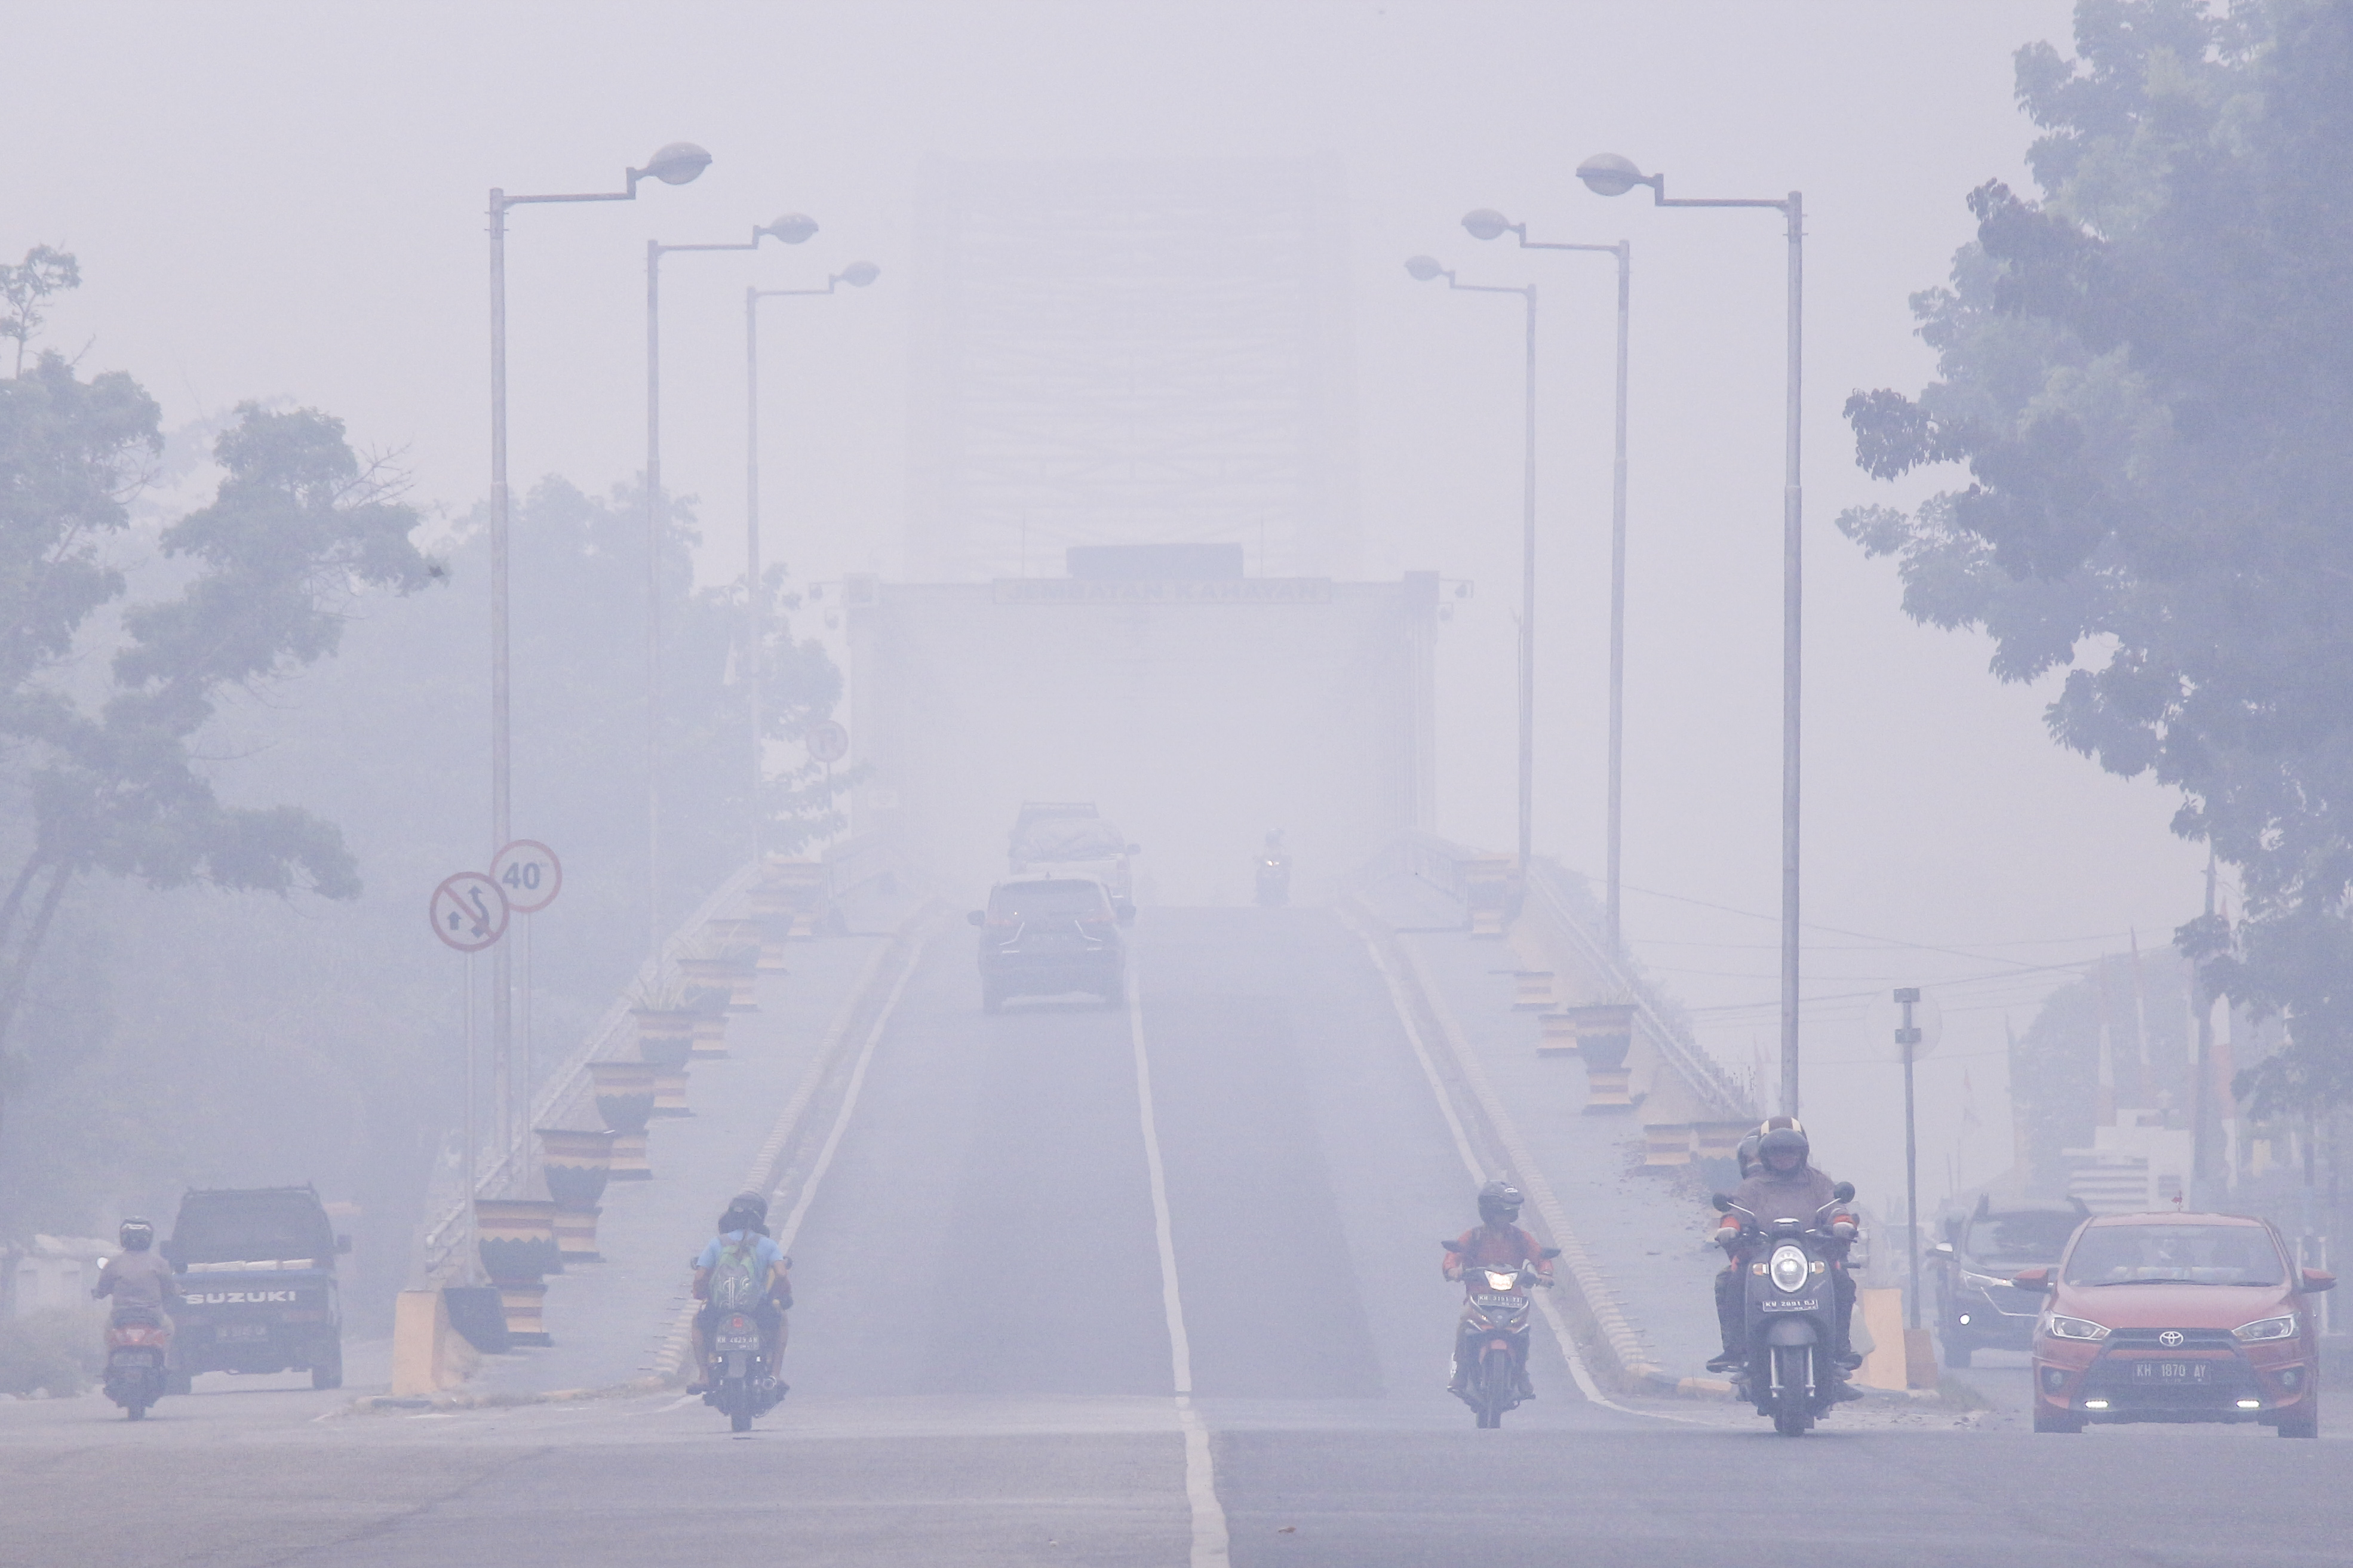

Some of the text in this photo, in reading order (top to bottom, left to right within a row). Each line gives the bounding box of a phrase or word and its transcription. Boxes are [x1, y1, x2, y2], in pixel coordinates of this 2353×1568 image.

[1007, 583, 1317, 599] JEMBATAN KAHAYAN
[502, 862, 541, 890] 40
[186, 1290, 296, 1305] SUZUKI
[2137, 1363, 2206, 1378] KH 1870 AY
